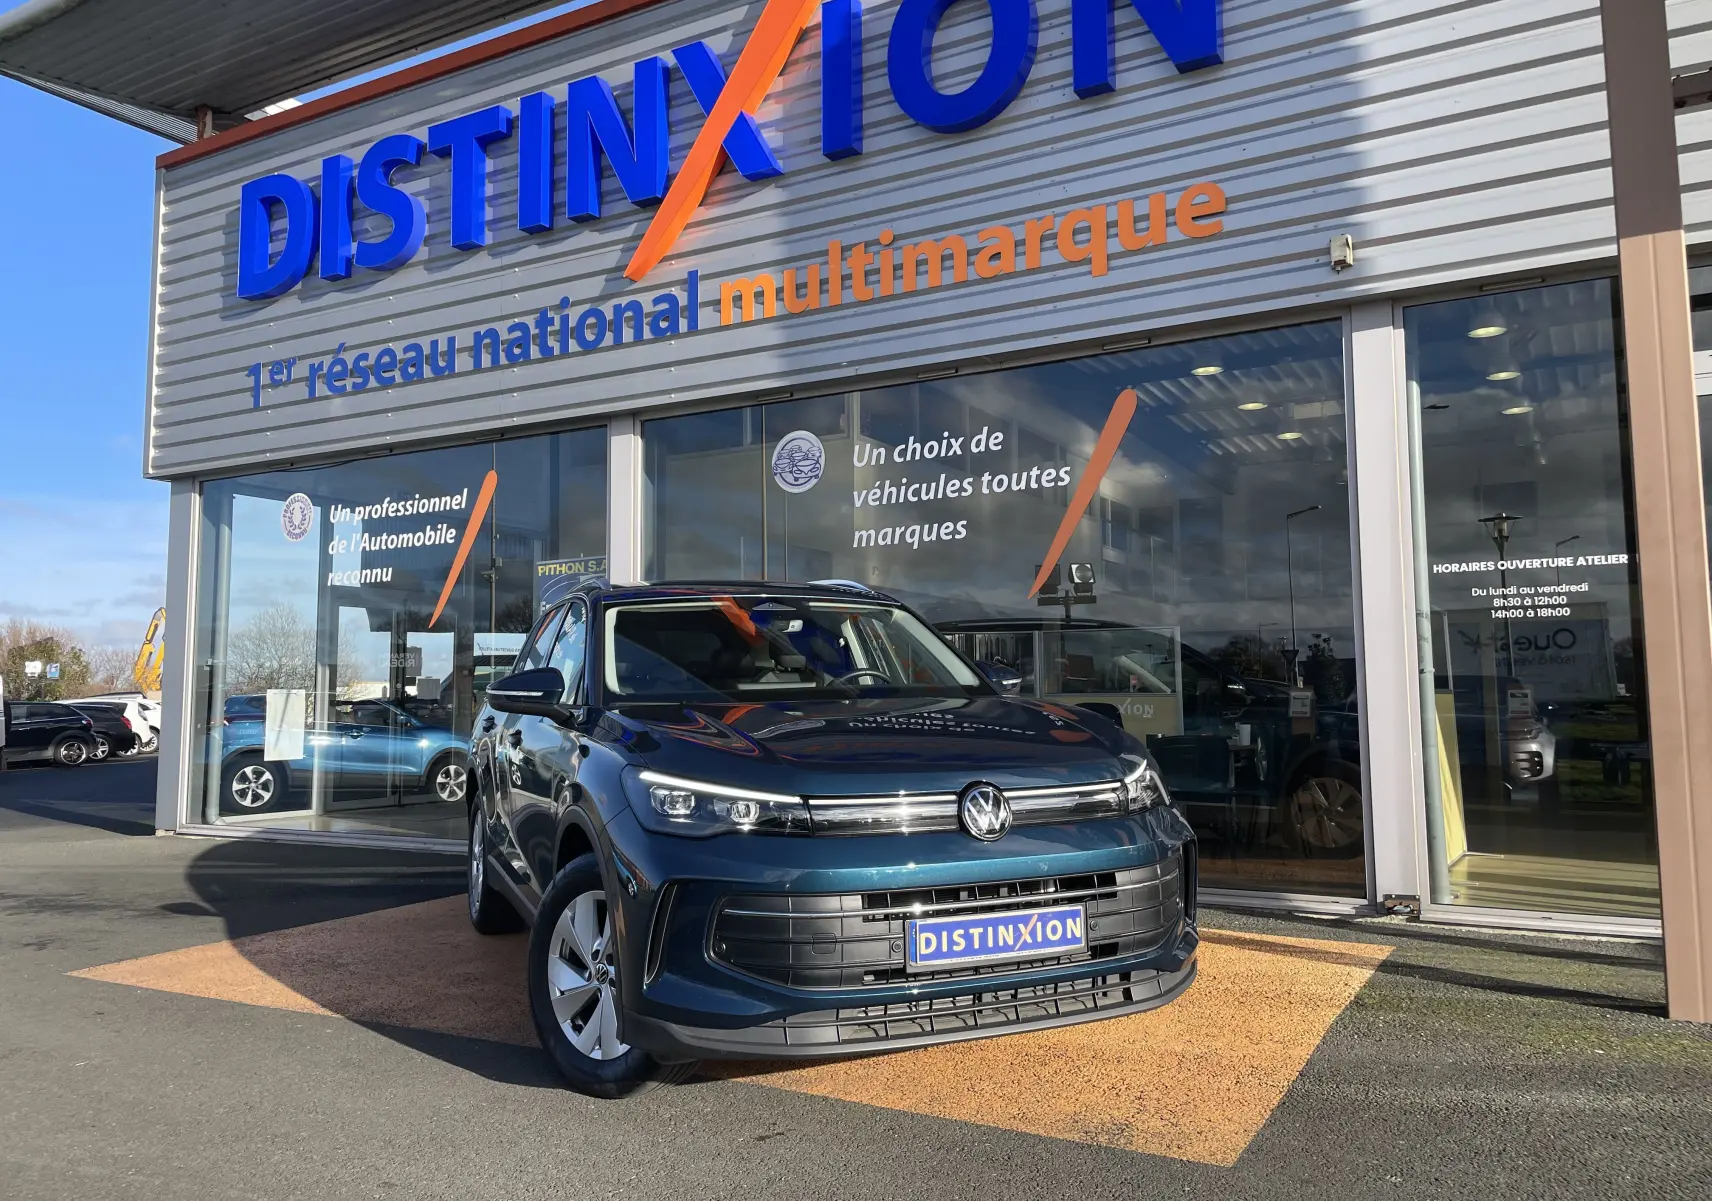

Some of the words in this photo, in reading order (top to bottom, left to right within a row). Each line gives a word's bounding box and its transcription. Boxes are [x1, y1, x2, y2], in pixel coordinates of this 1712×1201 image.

[236, 0, 1224, 299] DISTINXION
[307, 335, 457, 399] réseau
[473, 269, 699, 370] national
[719, 181, 1228, 326] multimarque
[853, 443, 886, 468] Un
[893, 431, 965, 463] choix
[970, 426, 1004, 454] de
[852, 473, 974, 508] véhicules
[981, 465, 1072, 494] toutes
[329, 503, 351, 524] Un
[353, 487, 469, 525] professionnel
[328, 534, 346, 555] de
[350, 523, 457, 552] l'Automobile
[852, 519, 968, 550] marques
[327, 566, 393, 587] reconnu
[538, 561, 585, 577] PITHON
[1433, 560, 1495, 574] HORAIRES
[1497, 556, 1574, 570] OUVERTURE
[1576, 554, 1629, 566] ATELIER
[1471, 587, 1487, 597] Du
[1489, 585, 1517, 596] lundi
[1519, 586, 1535, 594] au
[1537, 582, 1589, 593] vendredi
[1493, 597, 1521, 607] 8h30
[1523, 596, 1532, 606] à
[1534, 595, 1567, 606] 12h00
[1491, 608, 1524, 619] 14h00
[1526, 607, 1535, 617] à
[1536, 607, 1571, 617] 18h00
[919, 913, 1082, 955] DISTINXION
